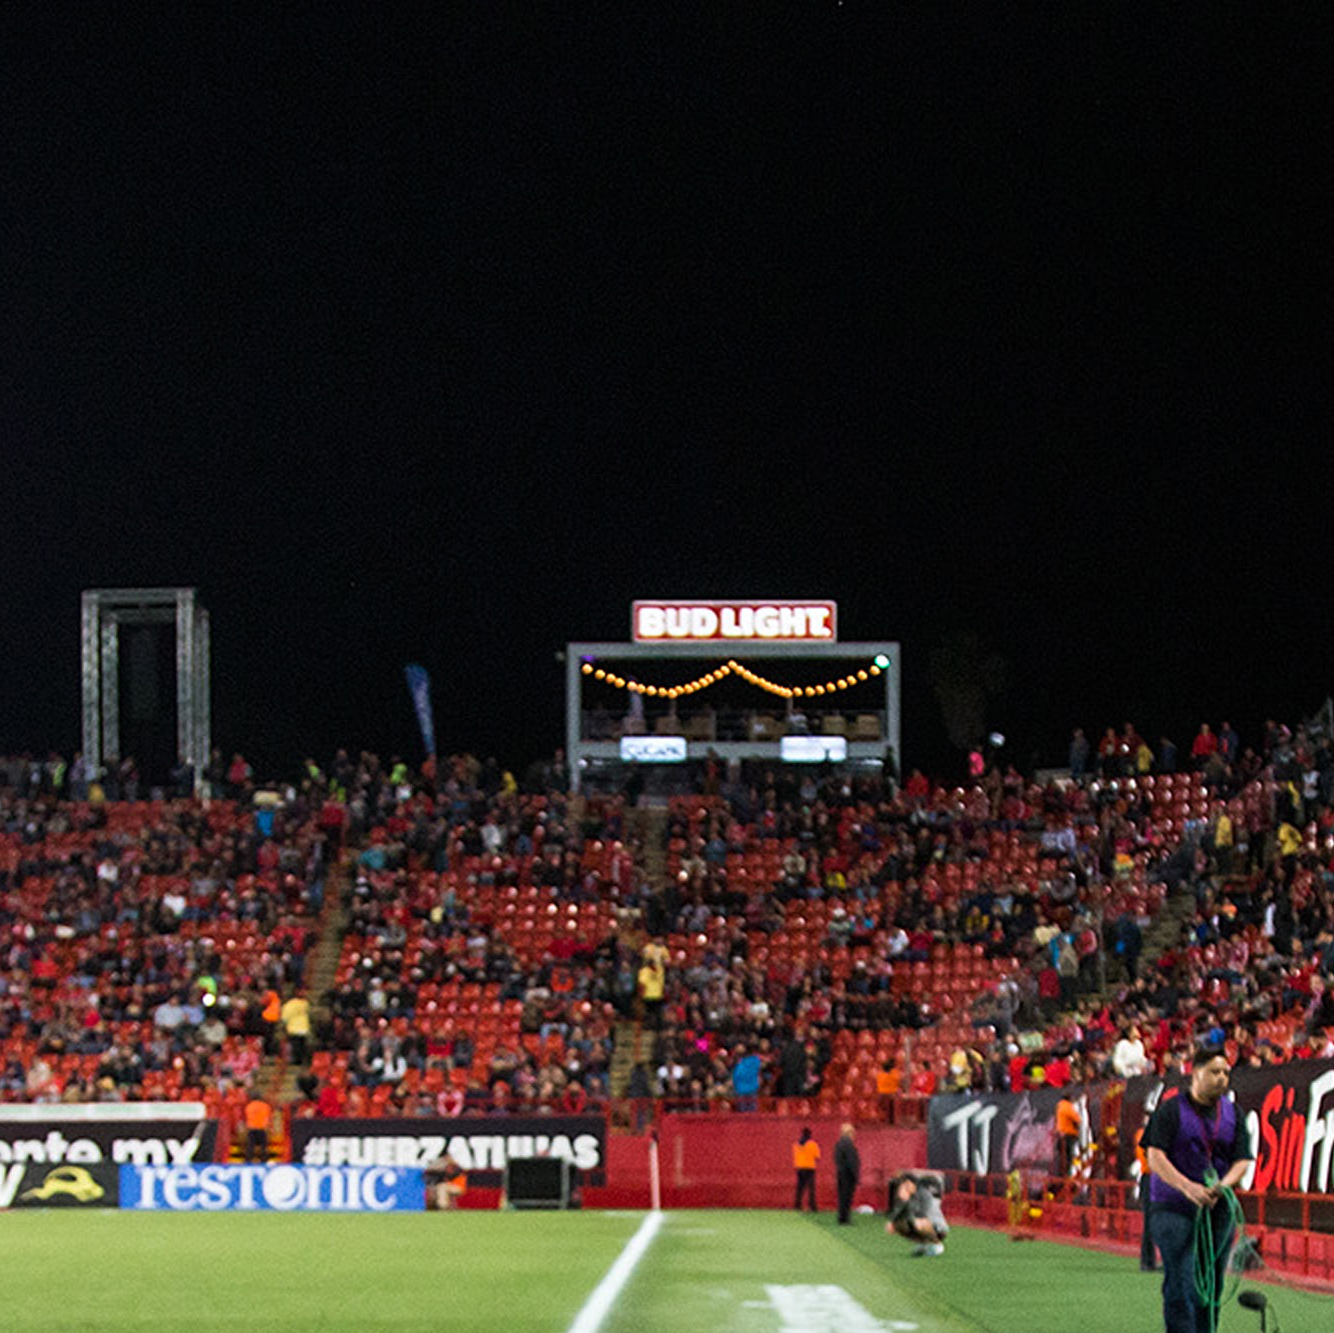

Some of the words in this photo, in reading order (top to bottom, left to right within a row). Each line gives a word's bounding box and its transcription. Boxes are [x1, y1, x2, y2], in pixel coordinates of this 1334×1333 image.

[638, 606, 718, 637] BUD
[719, 606, 831, 637] LIGHT
[942, 1101, 999, 1177] TJ
